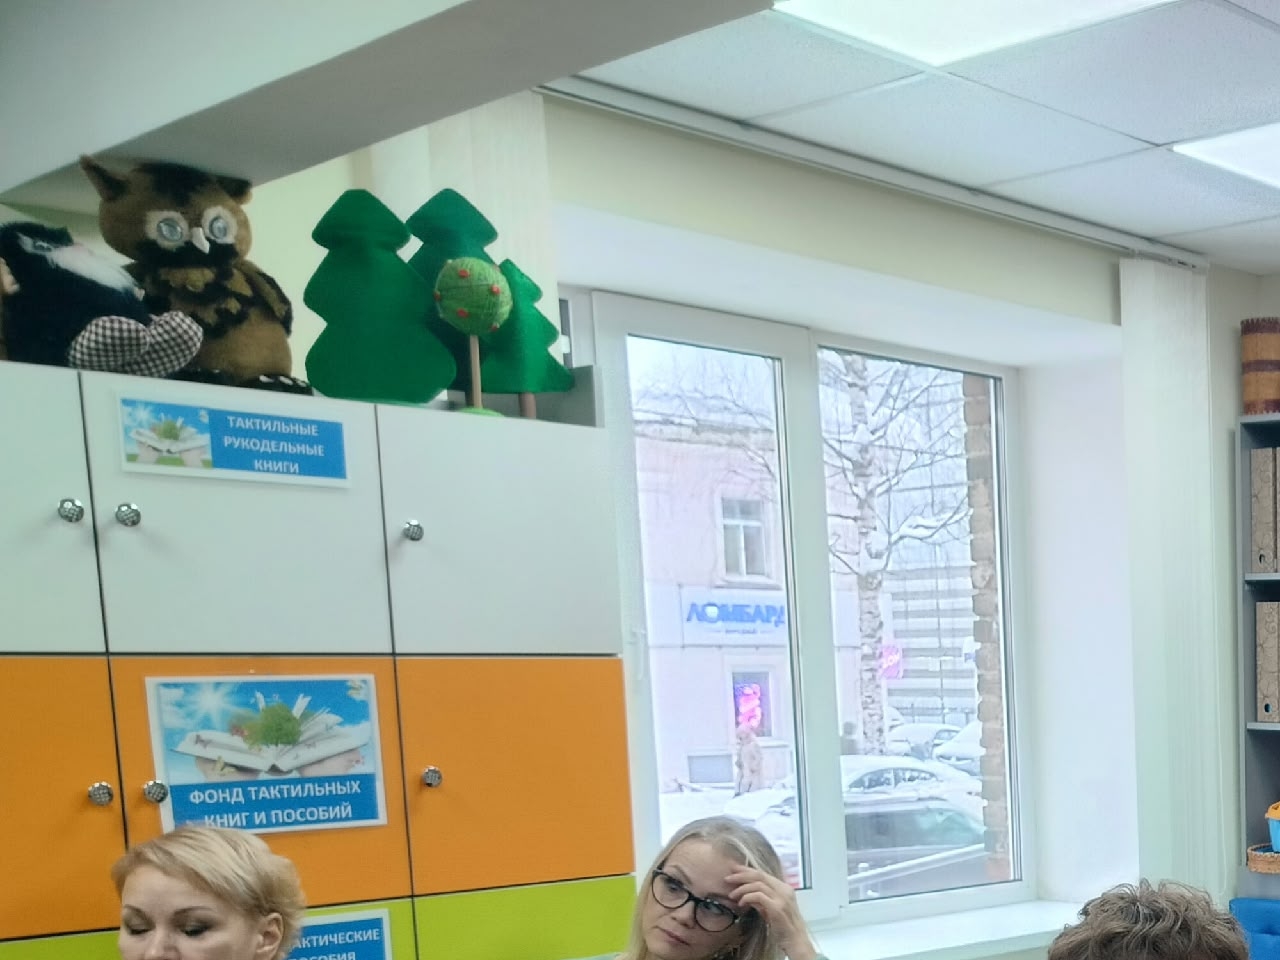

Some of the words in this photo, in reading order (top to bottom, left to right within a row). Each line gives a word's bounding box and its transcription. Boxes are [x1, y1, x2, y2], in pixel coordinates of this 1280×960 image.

[227, 415, 319, 436] ТАКТИЛЬНЫЕ
[223, 435, 325, 457] РУКОДЕЛЬНЫЕ
[253, 459, 299, 474] КНИГИ
[190, 787, 245, 804] ФОНД
[249, 780, 361, 800] ТАКТИЛЬНЫХ
[204, 811, 249, 828] КНИГ
[254, 811, 266, 825] И
[271, 802, 353, 824] ПОСОБИЙ
[292, 928, 380, 949] АКТИЧЕСКИЕ
